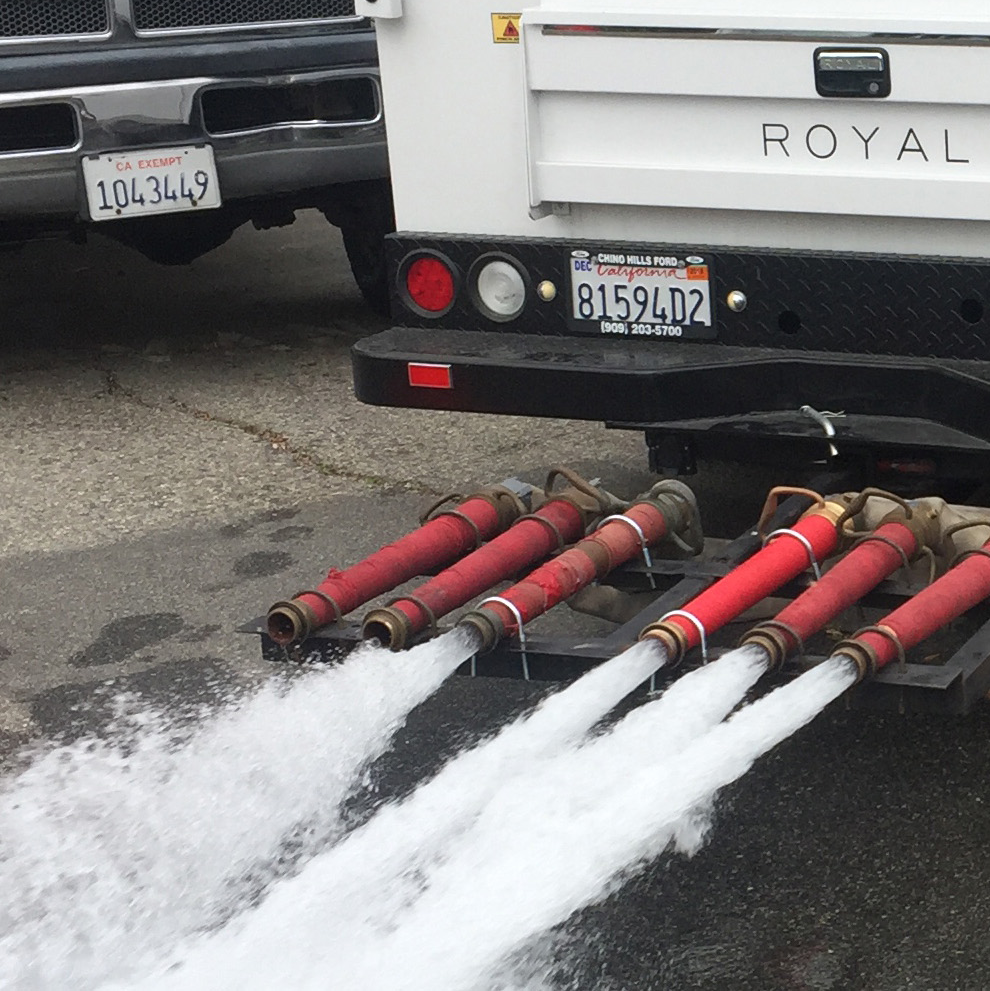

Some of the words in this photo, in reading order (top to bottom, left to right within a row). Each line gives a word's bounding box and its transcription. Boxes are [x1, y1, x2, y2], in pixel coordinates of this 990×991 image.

[761, 122, 970, 164] ROYAL
[115, 162, 132, 172] CA
[138, 156, 183, 169] EXEMPT
[97, 170, 209, 211] 1043449
[574, 260, 592, 271] DEC
[597, 253, 626, 265] CHINO
[626, 255, 652, 266] HILLS
[653, 256, 678, 267] FORD
[597, 264, 687, 283] California
[577, 282, 706, 327] 81594D2
[600, 321, 628, 335] (909)
[631, 323, 683, 337] 203-5700
